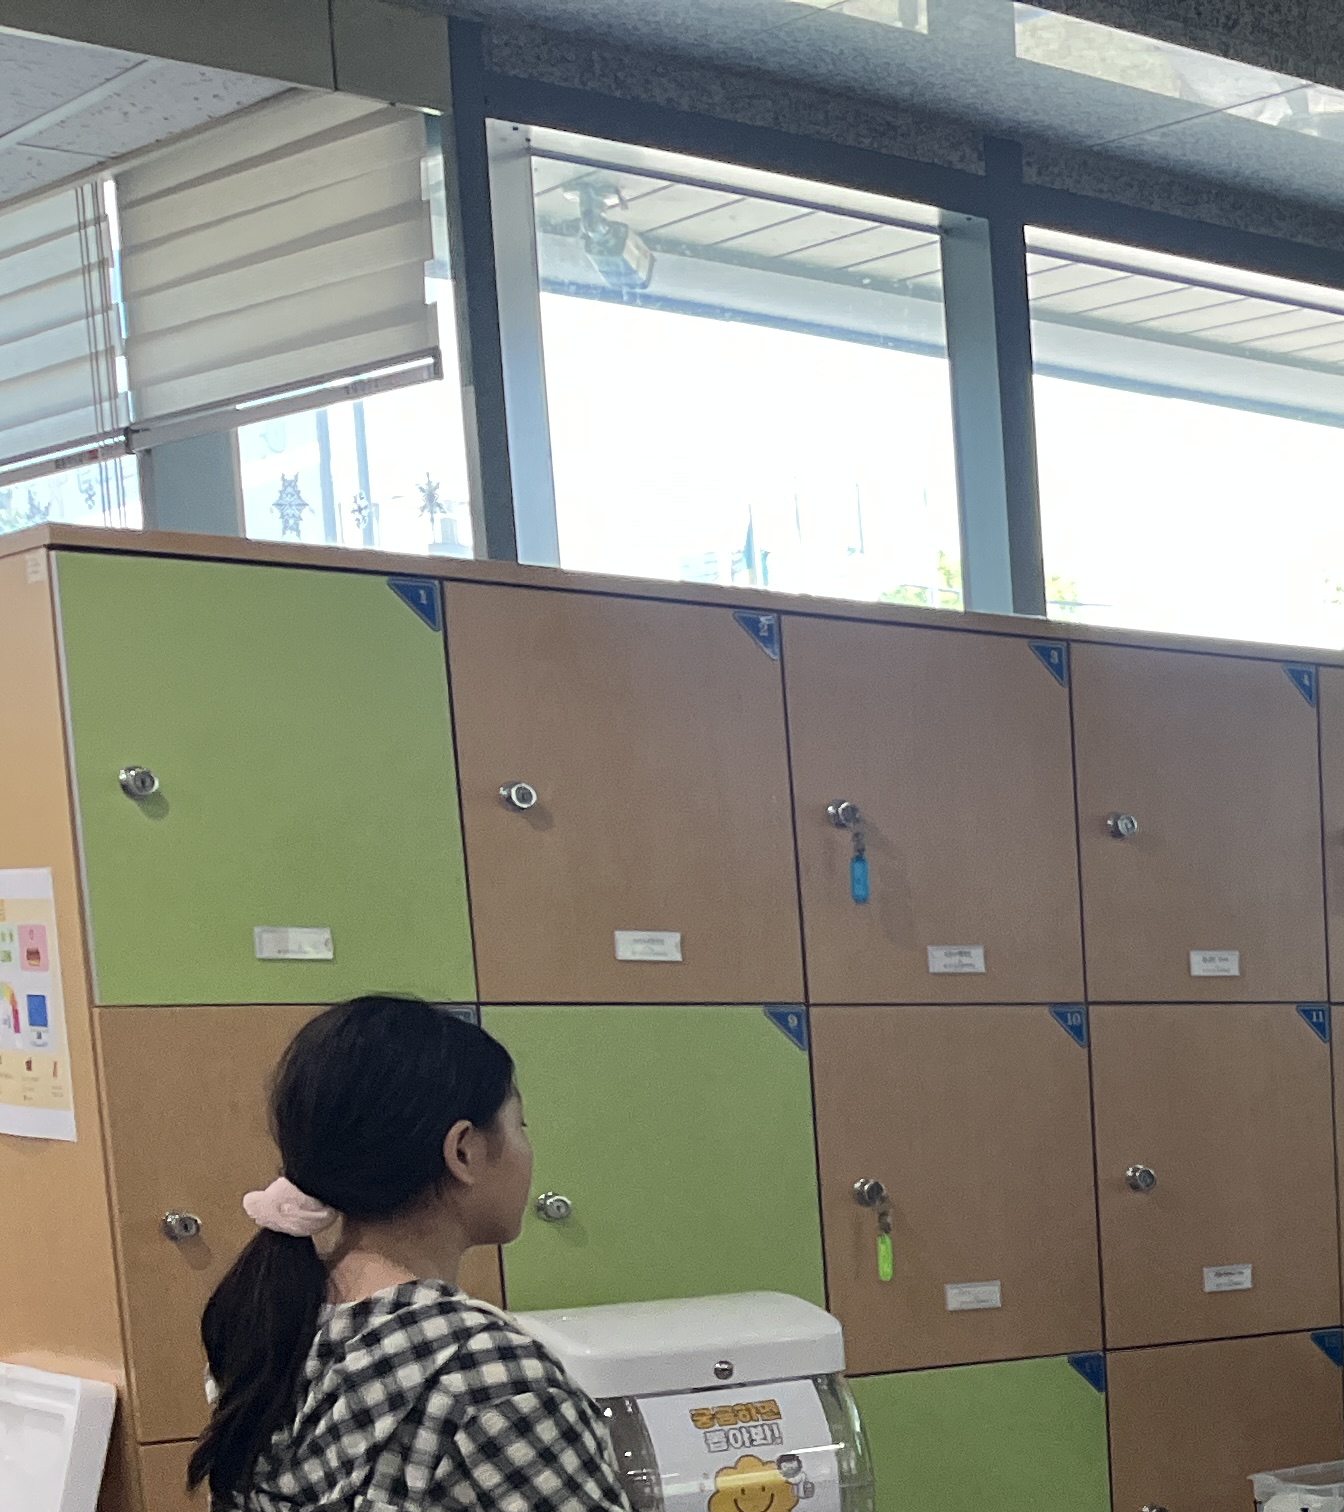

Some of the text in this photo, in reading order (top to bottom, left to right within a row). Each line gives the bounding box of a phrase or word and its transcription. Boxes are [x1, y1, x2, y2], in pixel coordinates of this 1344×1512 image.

[419, 589, 427, 605] 1
[787, 1013, 798, 1028] 9
[1065, 1012, 1080, 1026] 10
[1311, 1010, 1325, 1023] 11
[689, 1399, 782, 1429] 궁금하면
